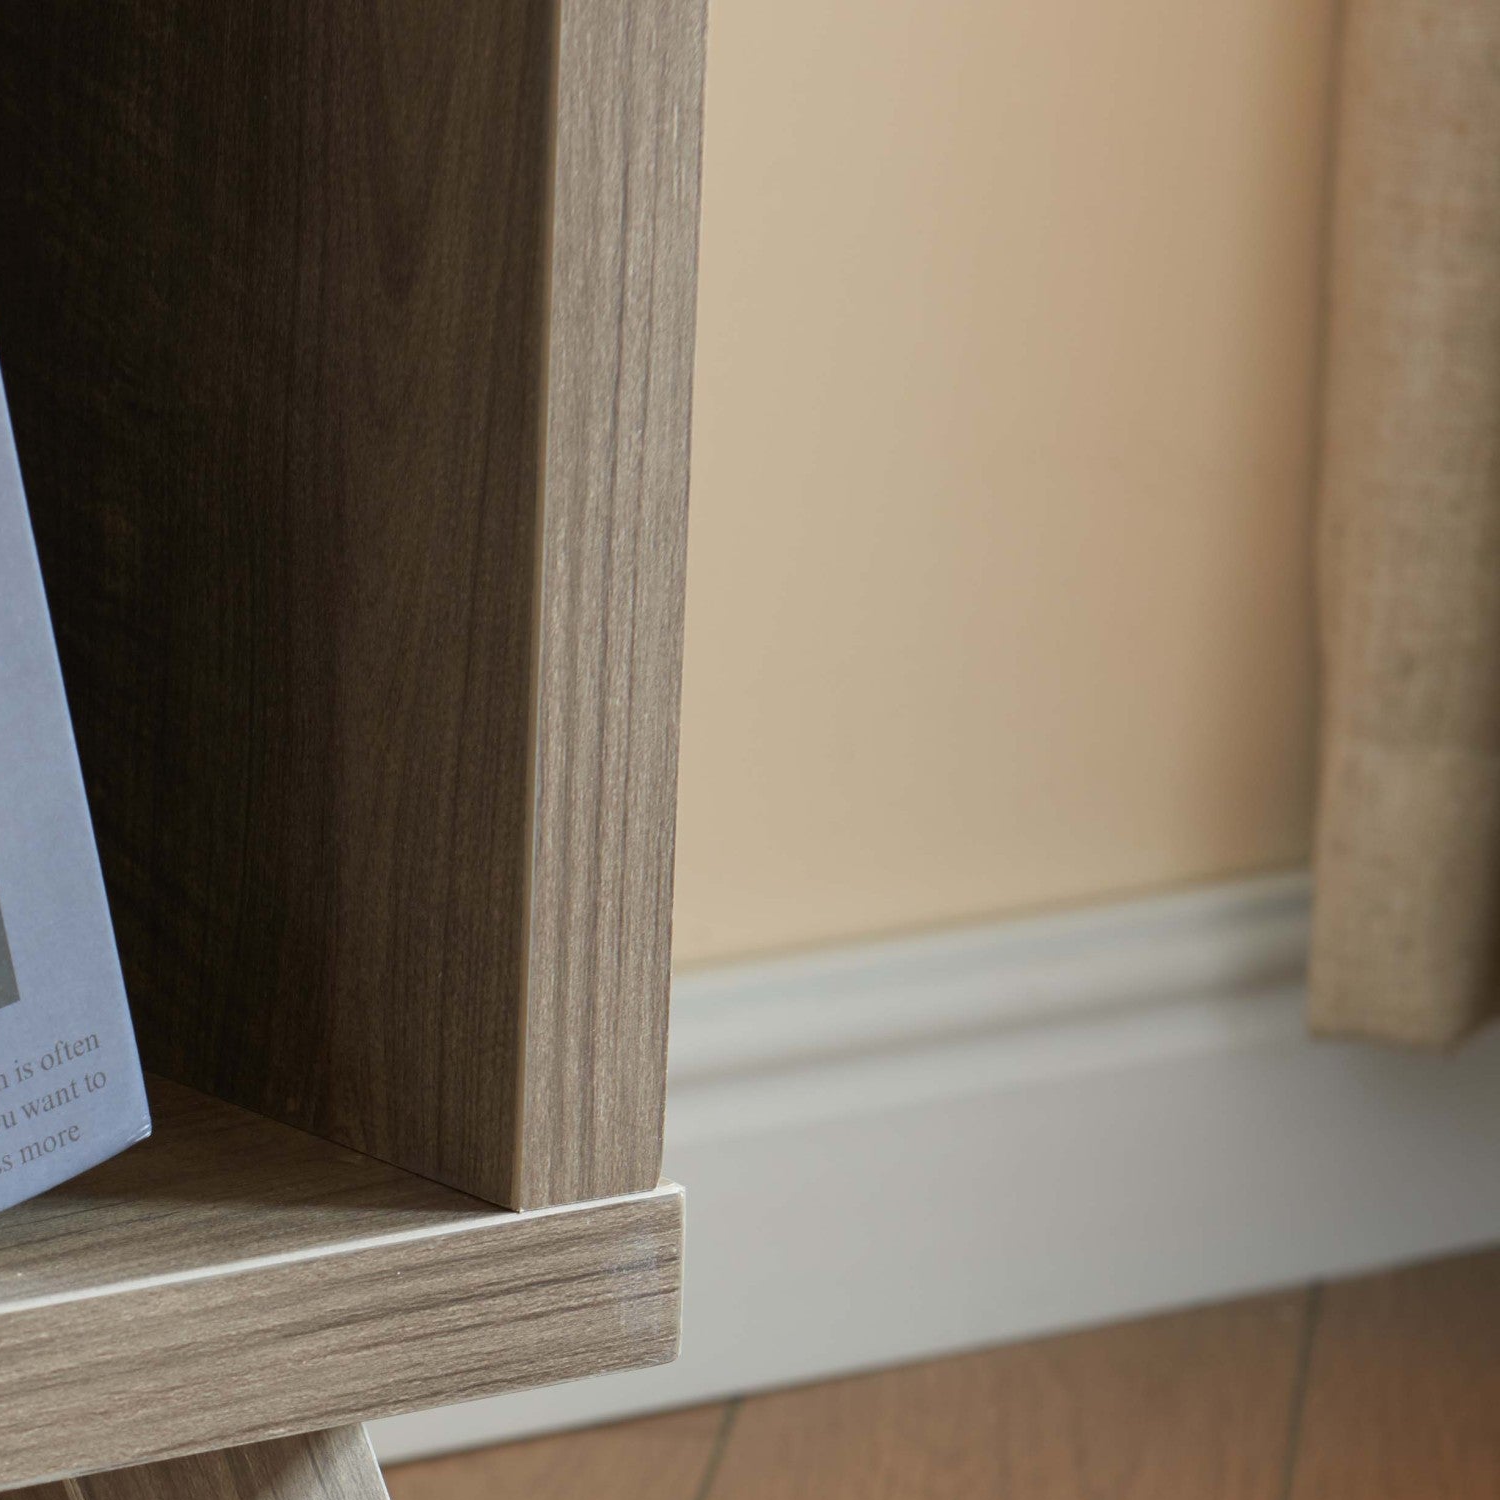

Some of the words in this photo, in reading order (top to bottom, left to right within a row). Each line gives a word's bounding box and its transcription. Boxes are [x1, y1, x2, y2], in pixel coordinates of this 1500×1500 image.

[14, 1059, 35, 1084] is
[39, 1032, 101, 1072] often
[21, 1079, 80, 1121] want
[84, 1070, 108, 1094] to
[19, 1124, 82, 1166] more
